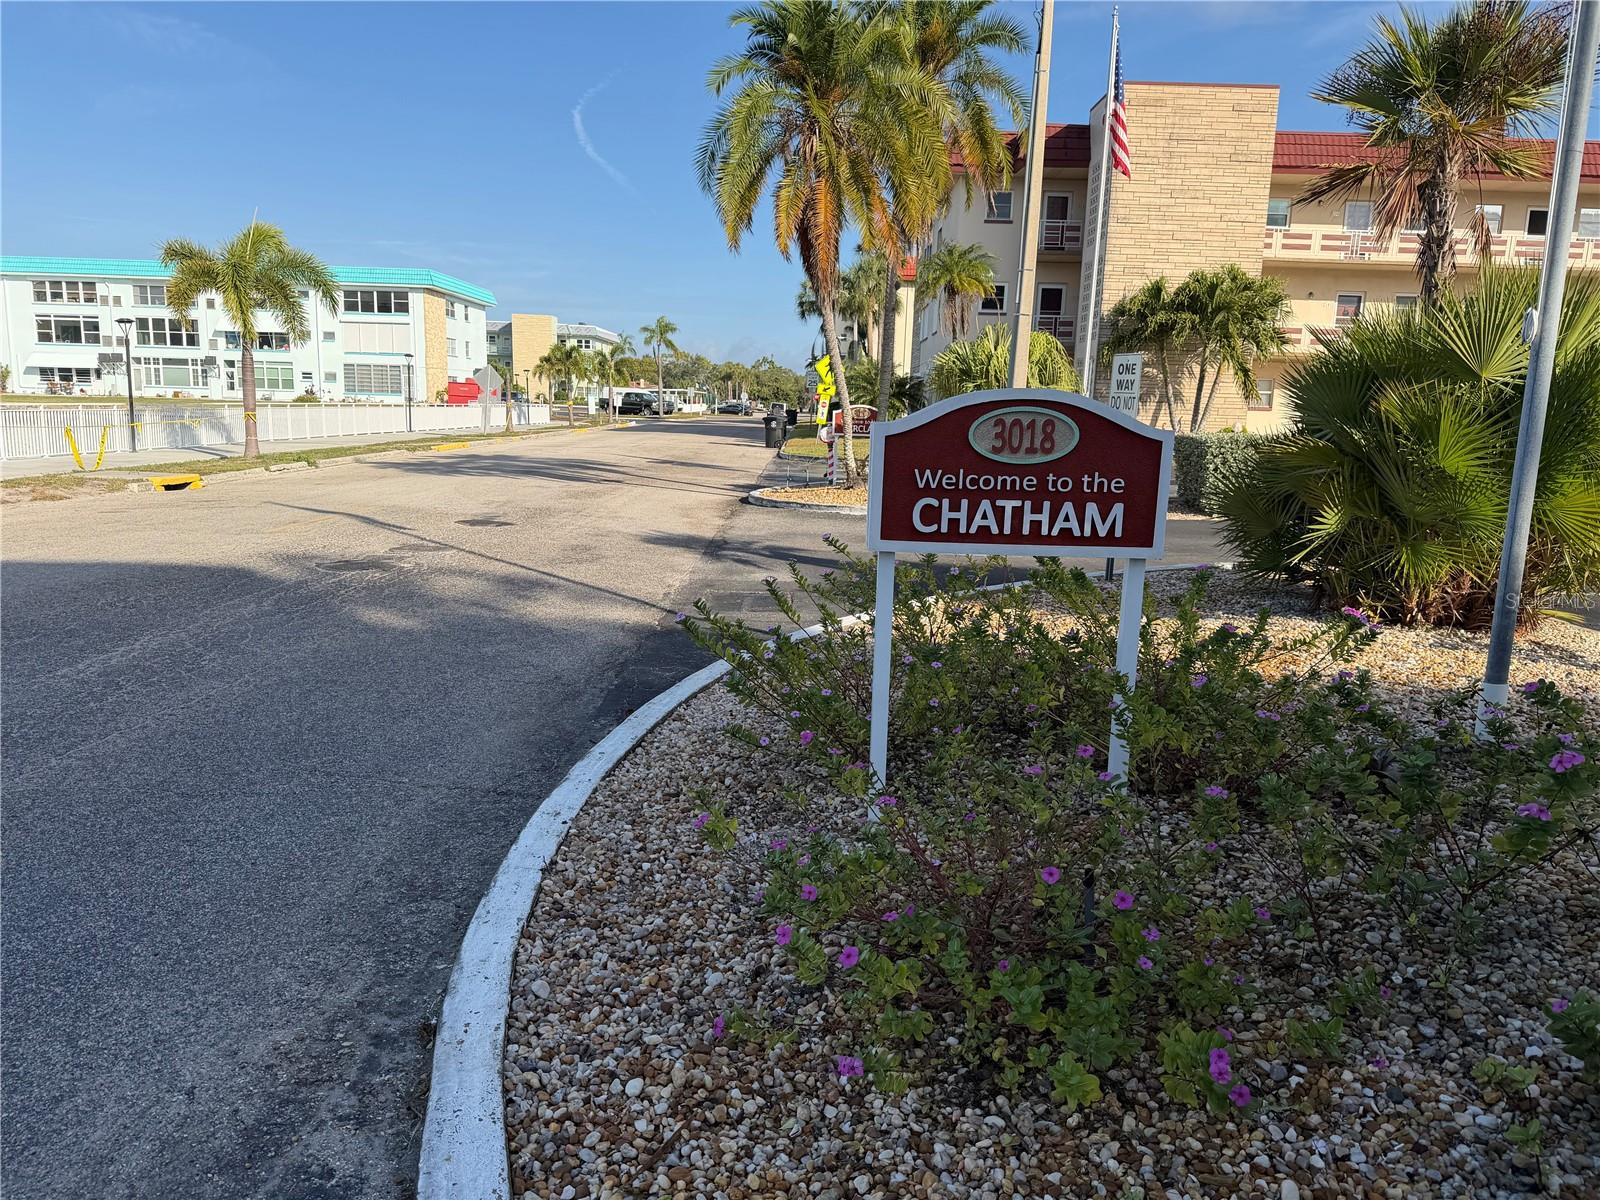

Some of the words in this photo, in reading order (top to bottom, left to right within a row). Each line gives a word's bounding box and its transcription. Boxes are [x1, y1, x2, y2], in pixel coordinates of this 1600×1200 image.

[1118, 363, 1136, 375] ONE
[808, 379, 818, 387] 25
[1116, 379, 1135, 391] WAY
[1111, 396, 1120, 410] DO
[1123, 396, 1136, 410] NOT
[852, 425, 871, 433] RCL
[991, 417, 1056, 455] 3018
[914, 468, 1037, 492] Welcome
[1047, 472, 1072, 492] to
[1082, 471, 1125, 493] the
[912, 497, 1125, 538] CHATHAM
